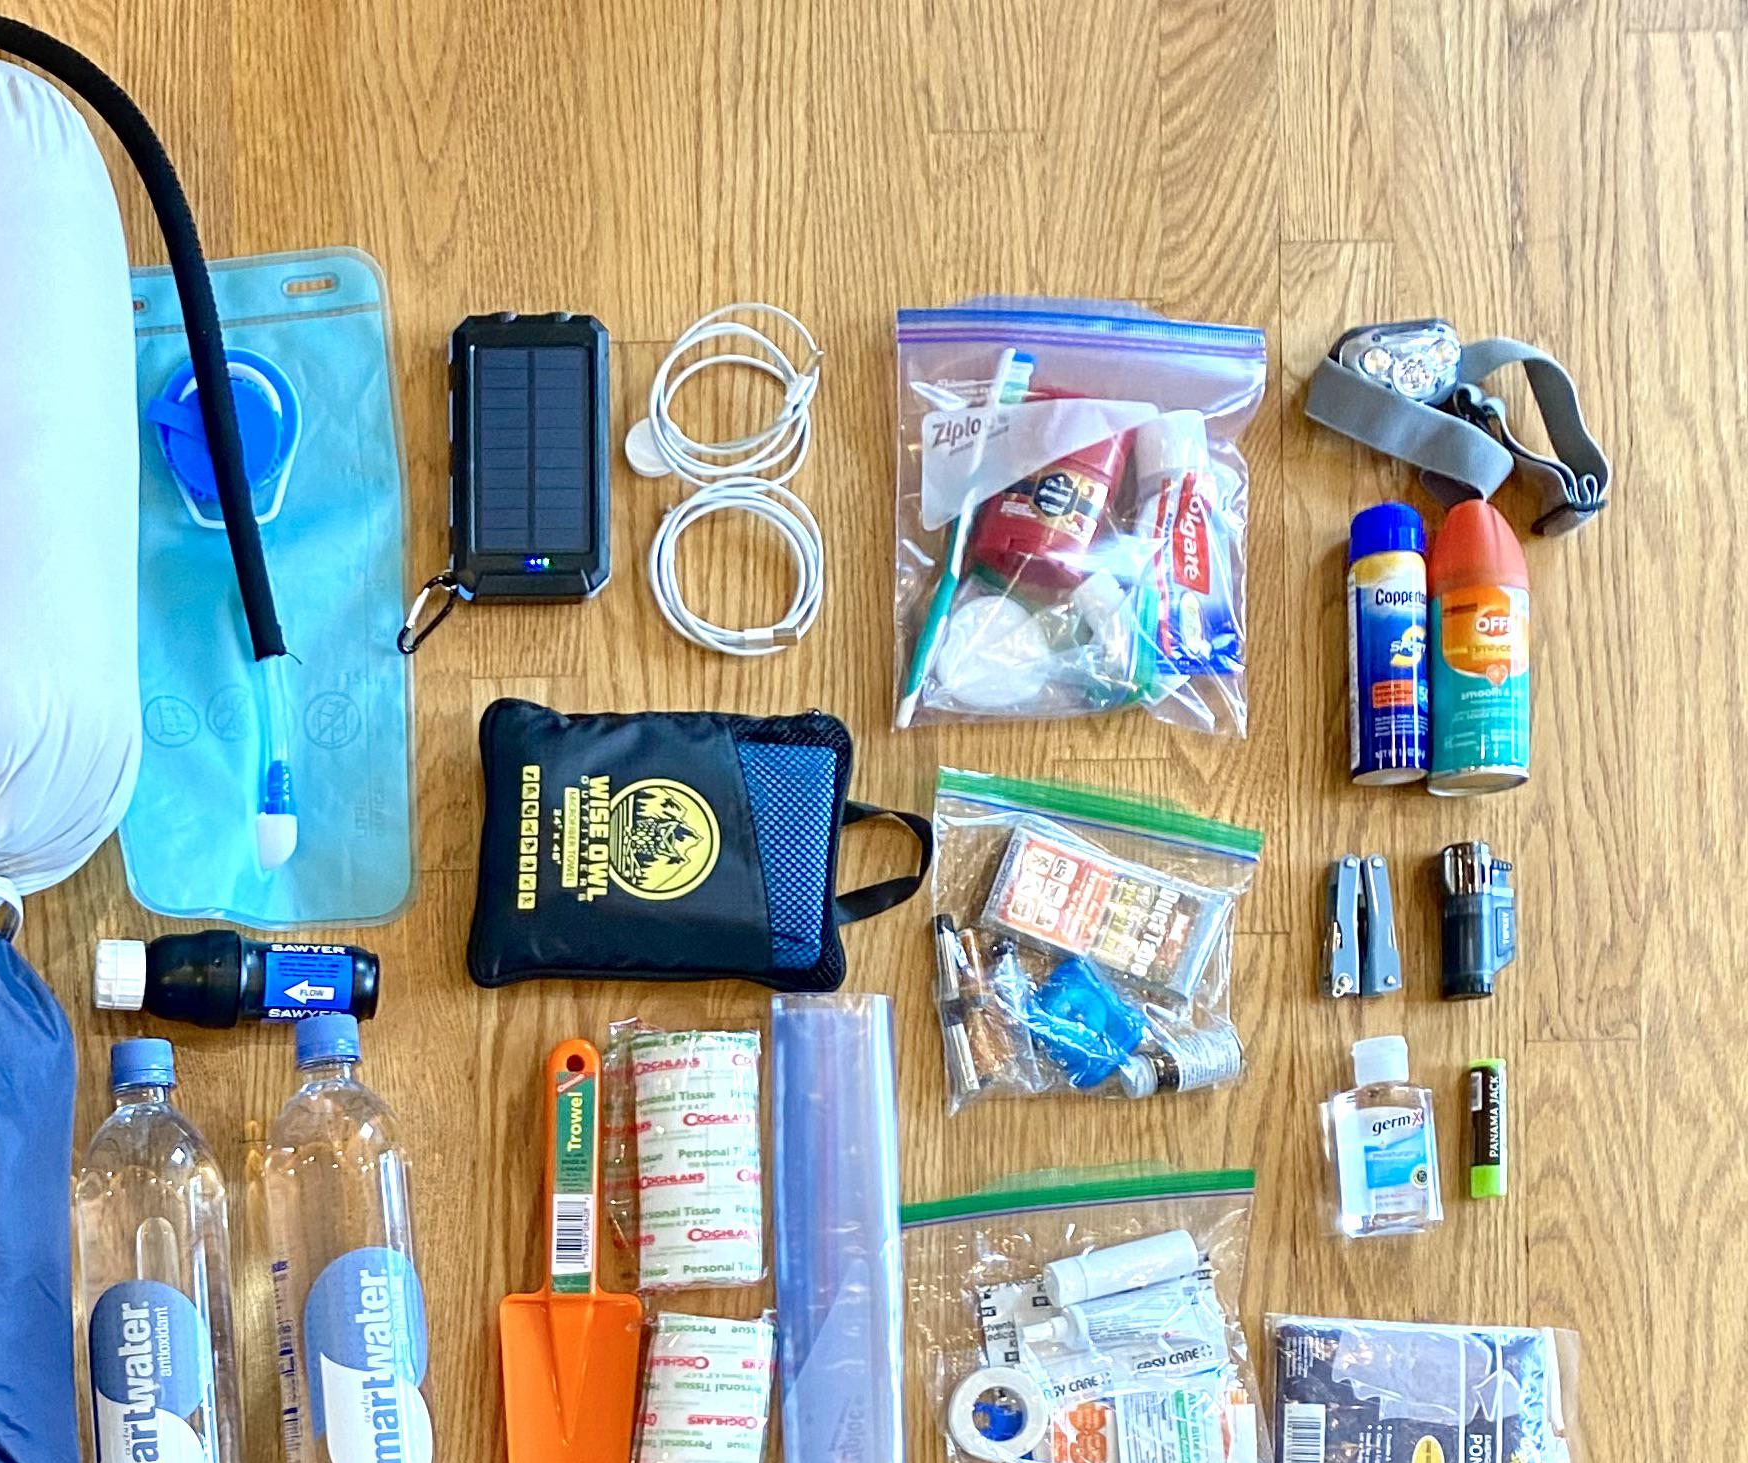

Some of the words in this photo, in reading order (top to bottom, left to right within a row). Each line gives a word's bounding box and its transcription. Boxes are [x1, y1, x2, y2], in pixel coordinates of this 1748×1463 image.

[588, 775, 611, 839] WISE
[578, 775, 590, 902] OUTFITTERS
[586, 843, 610, 902] OWL
[271, 944, 346, 954] SAWYER
[299, 989, 324, 997] FLOW
[1489, 1075, 1500, 1105] JACK
[567, 1091, 584, 1152] Trowel
[1489, 1107, 1500, 1158] PANAMA
[683, 1262, 735, 1274] Personal
[159, 1306, 172, 1378] antioxidant
[674, 1381, 712, 1392] Tissue
